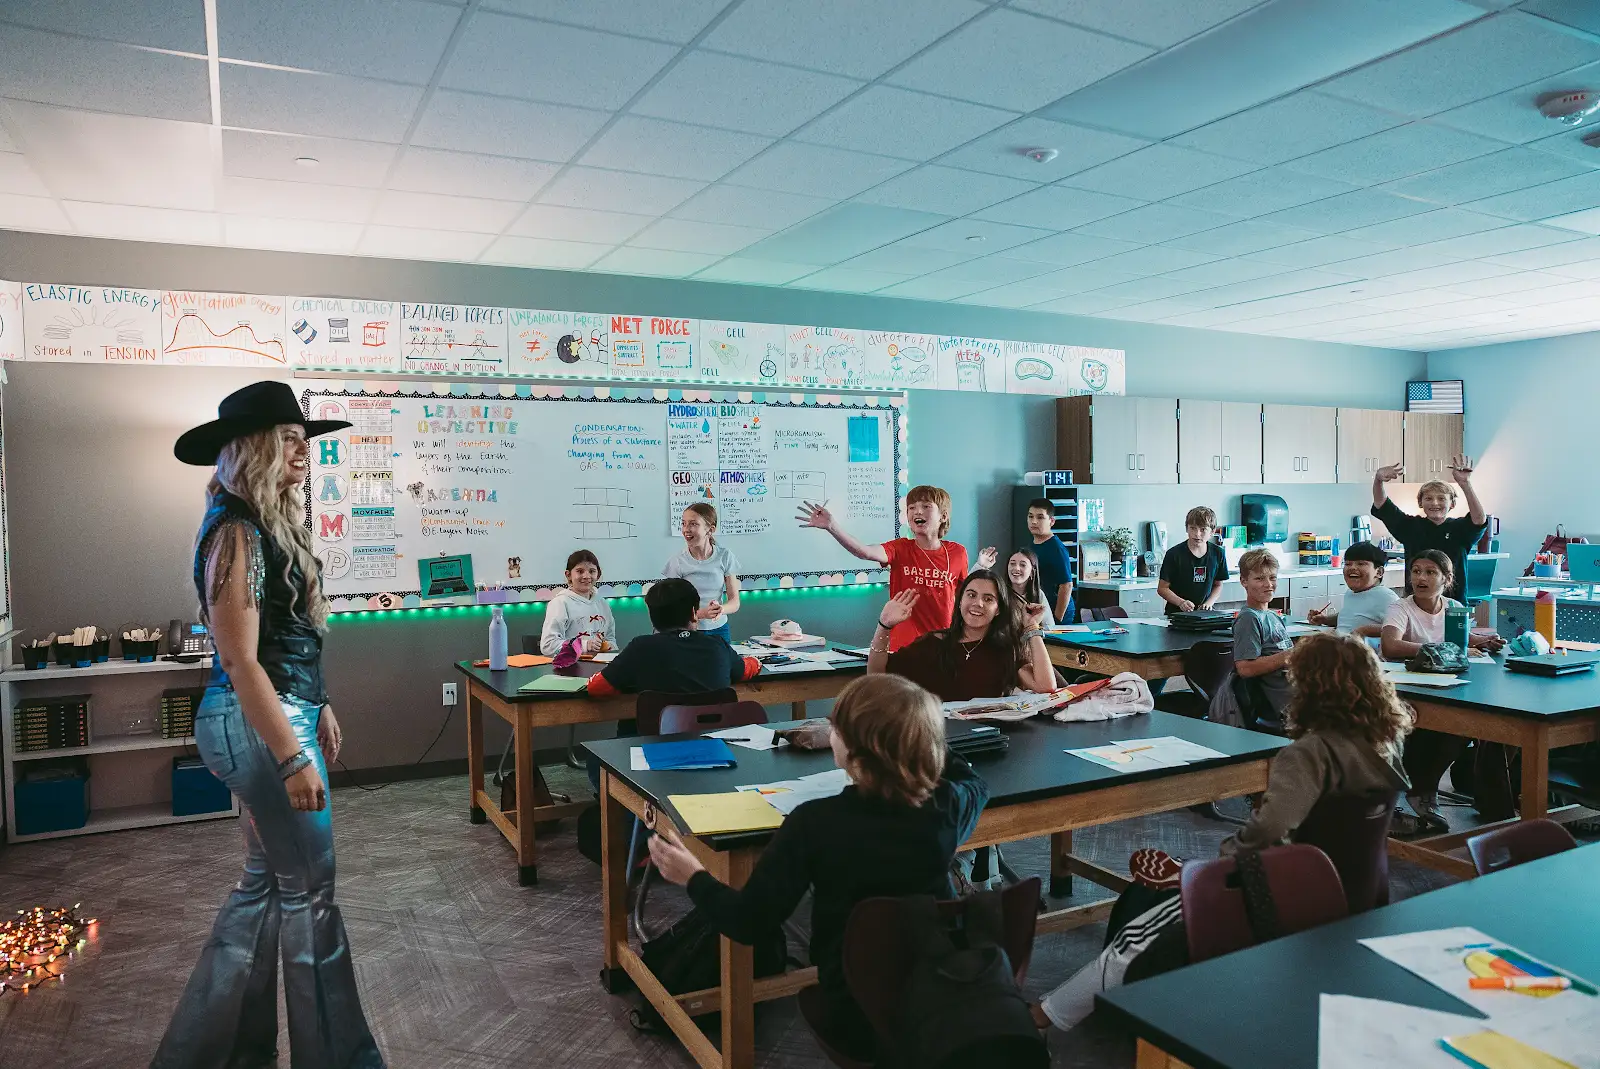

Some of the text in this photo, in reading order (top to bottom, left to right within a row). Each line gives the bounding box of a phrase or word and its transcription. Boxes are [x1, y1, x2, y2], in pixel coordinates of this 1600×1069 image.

[26, 284, 161, 313] ELASTIC ENERGY
[163, 290, 247, 319] gravitational
[292, 299, 395, 316] CHEMICAL ENERGY
[401, 303, 504, 325] BALANCED FORCES
[510, 310, 569, 326] UNBALANCED
[611, 316, 643, 336] NET
[651, 317, 691, 337] FORCE
[33, 344, 156, 361] Stored in TENSION
[420, 360, 449, 371] CHANGE
[464, 363, 497, 372] MOTION
[422, 404, 514, 420] LEARNING
[417, 419, 519, 435] OBJECTIVE
[676, 421, 699, 430] WATER
[412, 440, 425, 448] We
[432, 438, 448, 448] will
[500, 439, 516, 449] the
[603, 436, 613, 445] of
[319, 439, 340, 465] H
[456, 452, 472, 461] the
[611, 449, 633, 460] from
[579, 461, 599, 472] GAS
[605, 461, 613, 469] to
[672, 471, 717, 485] GEOSPHERE
[720, 471, 768, 484] ATMOSPHERE
[319, 475, 341, 501] A
[320, 513, 344, 538] M
[914, 576, 945, 589] IS LIFE
